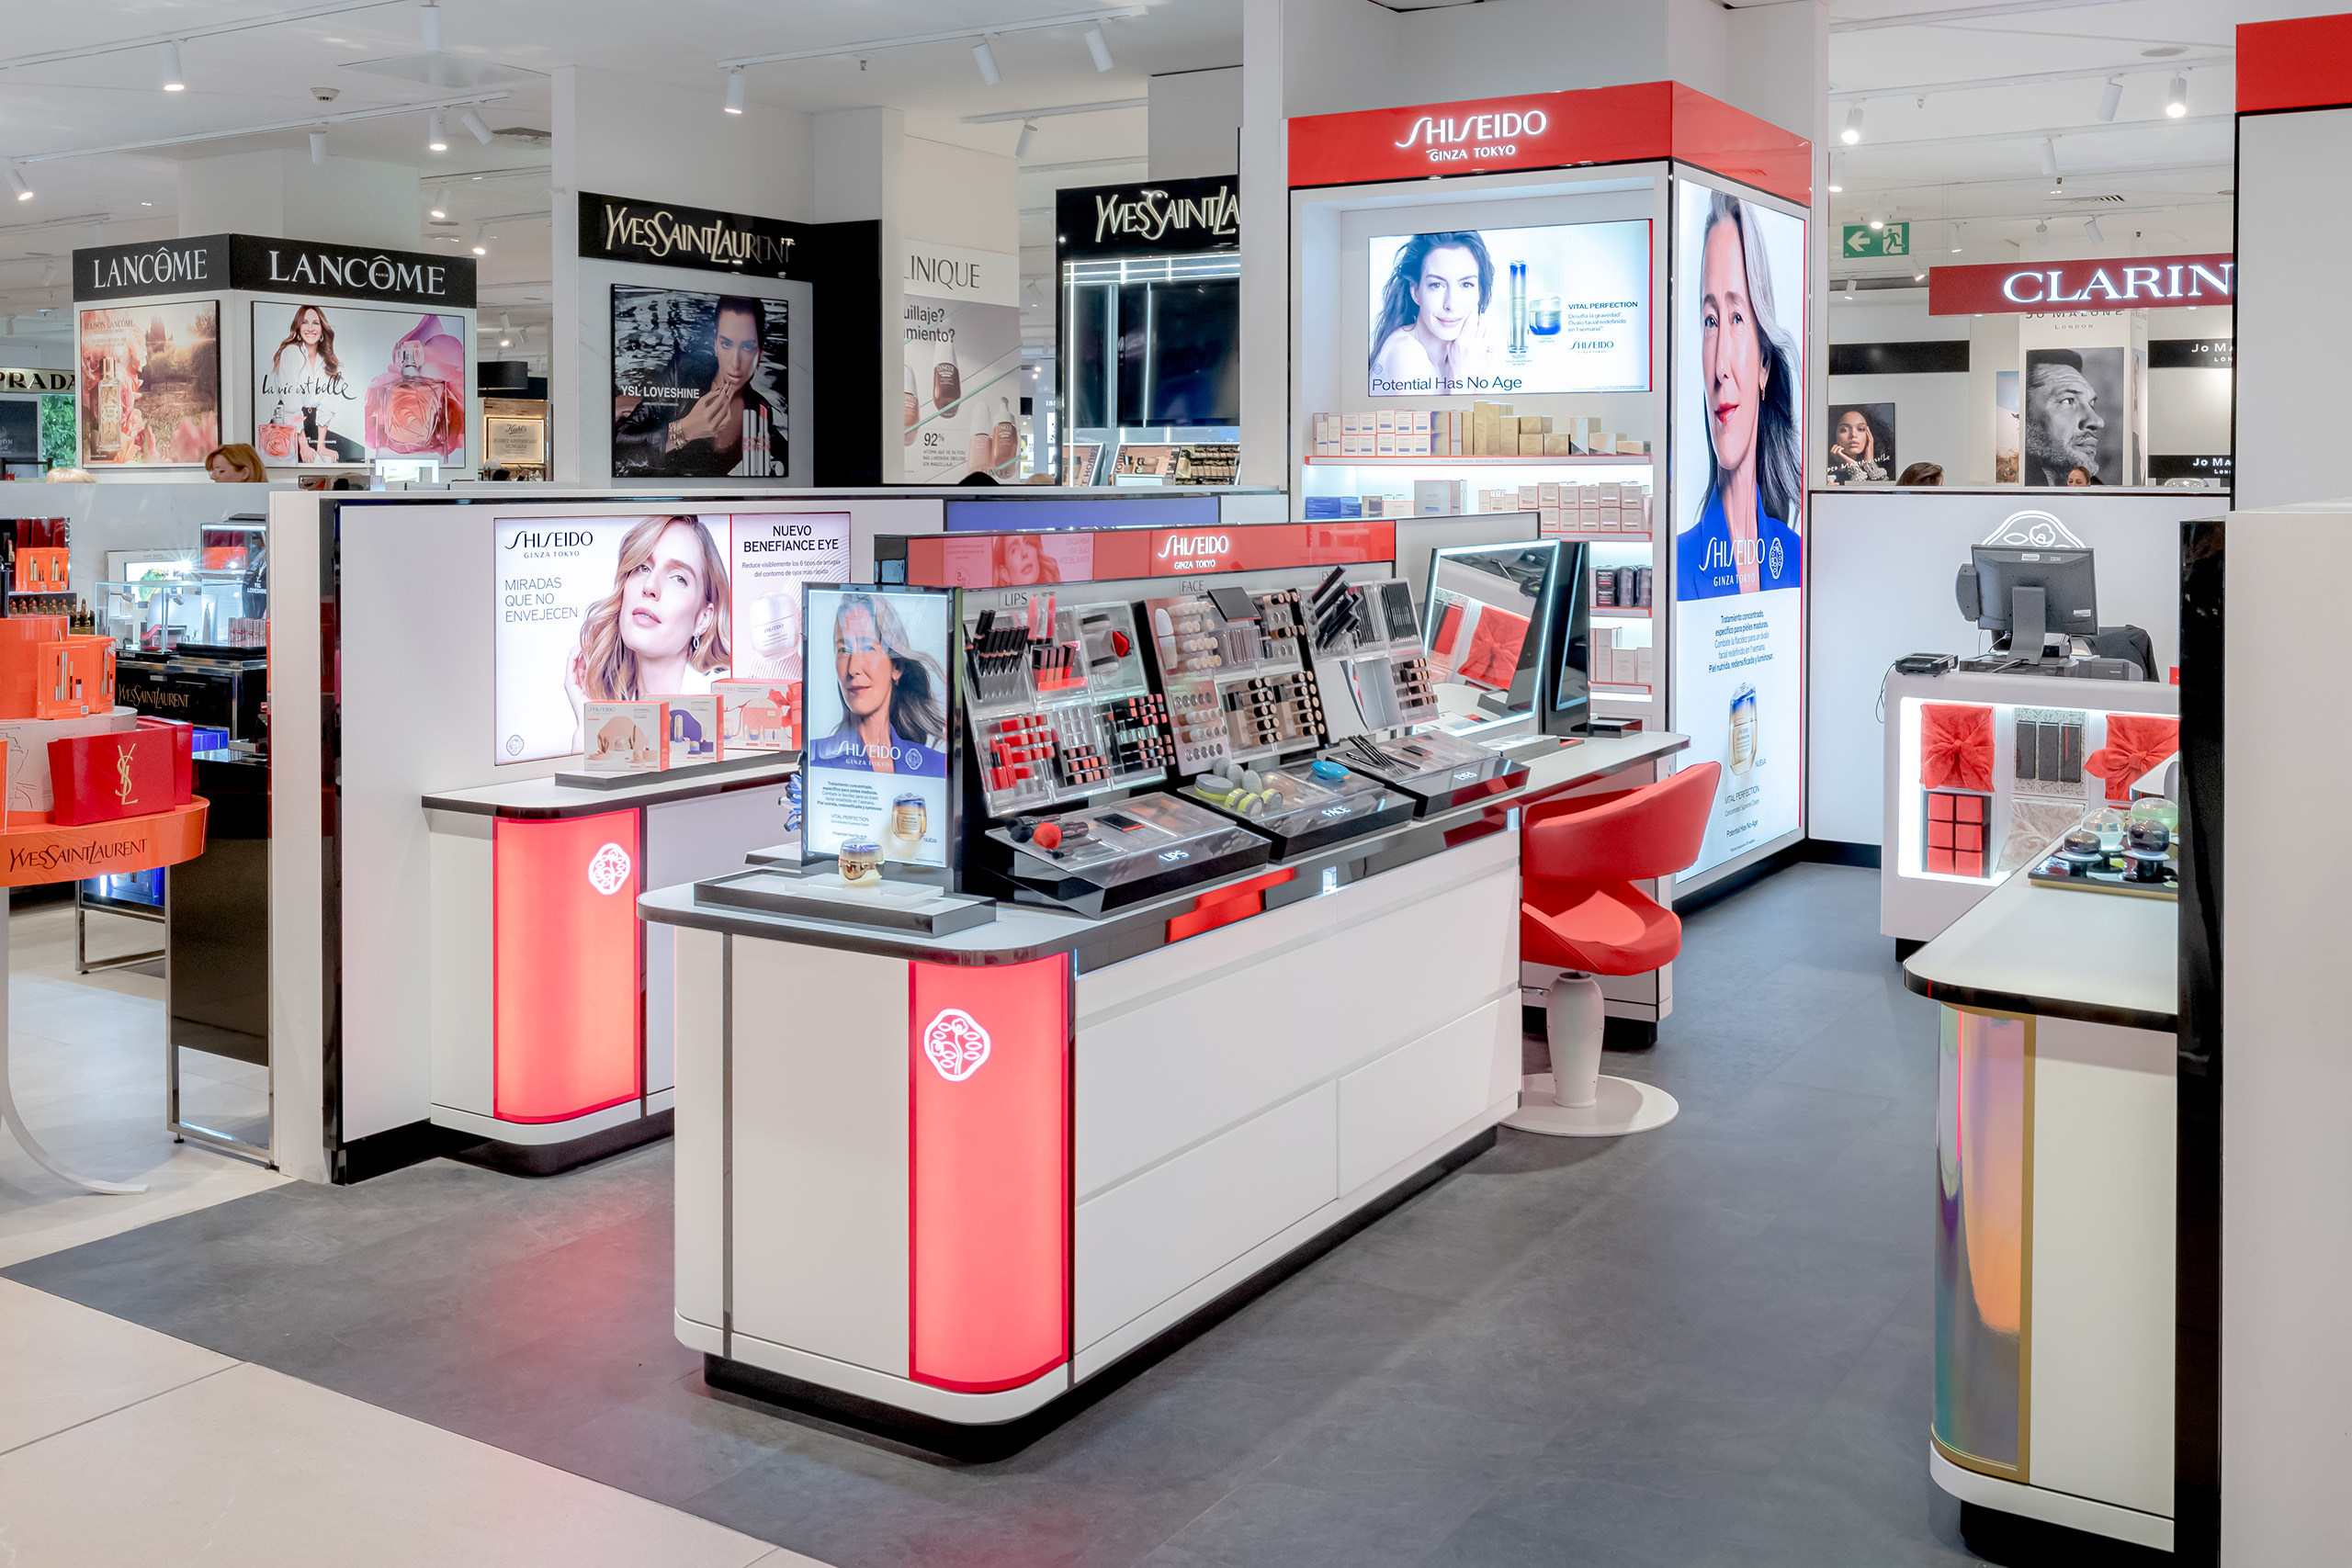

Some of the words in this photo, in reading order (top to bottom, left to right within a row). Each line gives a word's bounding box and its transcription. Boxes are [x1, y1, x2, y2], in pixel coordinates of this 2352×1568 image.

[1395, 110, 1547, 148] SHISEIDO
[1430, 149, 1468, 162] GINZA
[1474, 145, 1516, 158] TOKYO
[94, 246, 207, 288] LANCÔME
[269, 251, 446, 295] LANCÔME
[904, 325, 956, 343] miento?
[1568, 341, 1613, 350] SHISEIDO
[1373, 378, 1431, 391] Potential
[1435, 378, 1464, 389] Has
[1467, 377, 1488, 389] No
[1492, 376, 1522, 391] Age
[622, 386, 641, 396] YSL
[643, 387, 700, 399] LOVESHINE
[2193, 458, 2208, 467] Jo
[773, 525, 812, 536] NUEVO
[504, 531, 594, 549] SHISEIDO
[744, 539, 815, 552] BENEFIANCE
[818, 538, 839, 550] EYE
[1158, 535, 1229, 558] SHISEIDO
[1699, 536, 1765, 571] SHISEIDO
[1174, 560, 1193, 570] GINZA
[1195, 559, 1216, 569] TOKYO
[505, 577, 562, 591] MIRADAS
[1182, 580, 1204, 592] FACE
[1713, 575, 1734, 586] GINZA
[1736, 573, 1755, 584] TOKYO
[505, 594, 532, 606] QUE
[536, 593, 554, 604] NO
[1005, 592, 1027, 606] LIPS
[505, 607, 578, 623] ENVEJECEN
[1721, 614, 1741, 624] Tratamiento
[832, 740, 901, 761] SHISEIDO
[1736, 784, 1759, 800] PERFECTION
[1321, 807, 1351, 817] FACE
[1159, 850, 1189, 862] LIPS
